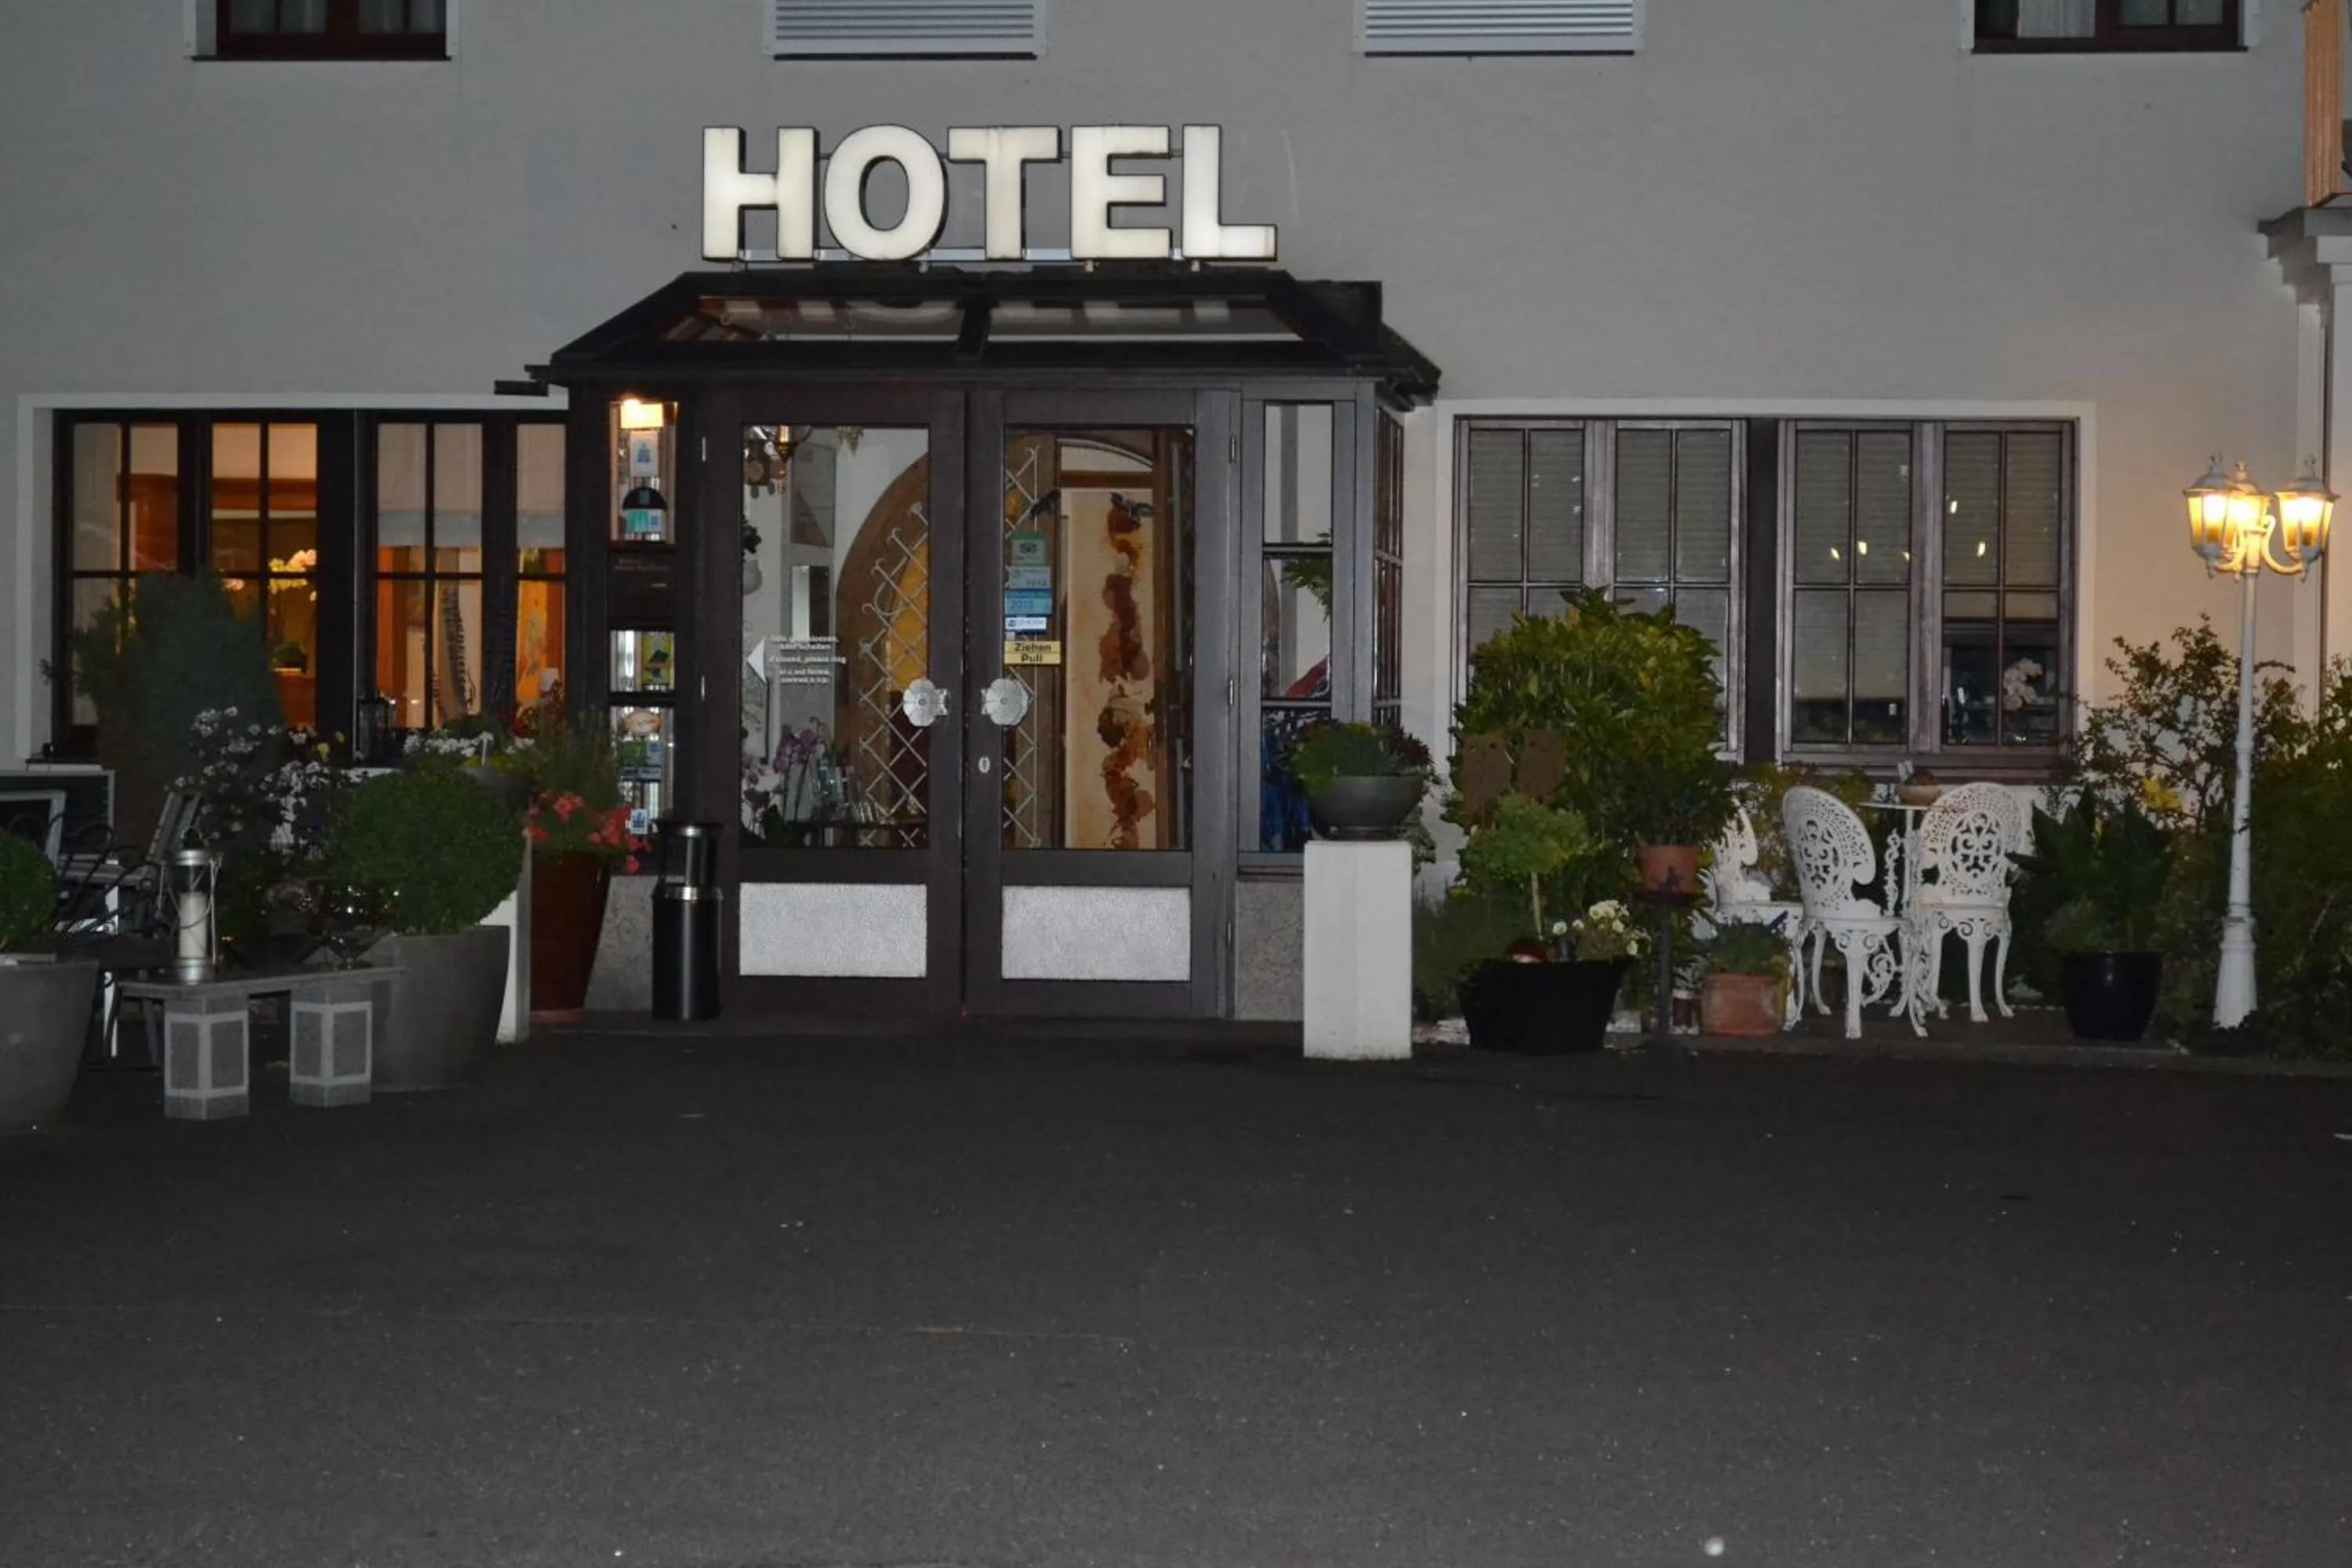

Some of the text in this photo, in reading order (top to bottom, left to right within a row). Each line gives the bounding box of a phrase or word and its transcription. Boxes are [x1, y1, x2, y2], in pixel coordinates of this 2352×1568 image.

[702, 124, 1277, 261] HOTEL
[1014, 642, 1051, 652] Ziehen
[1021, 653, 1044, 662] Pull
